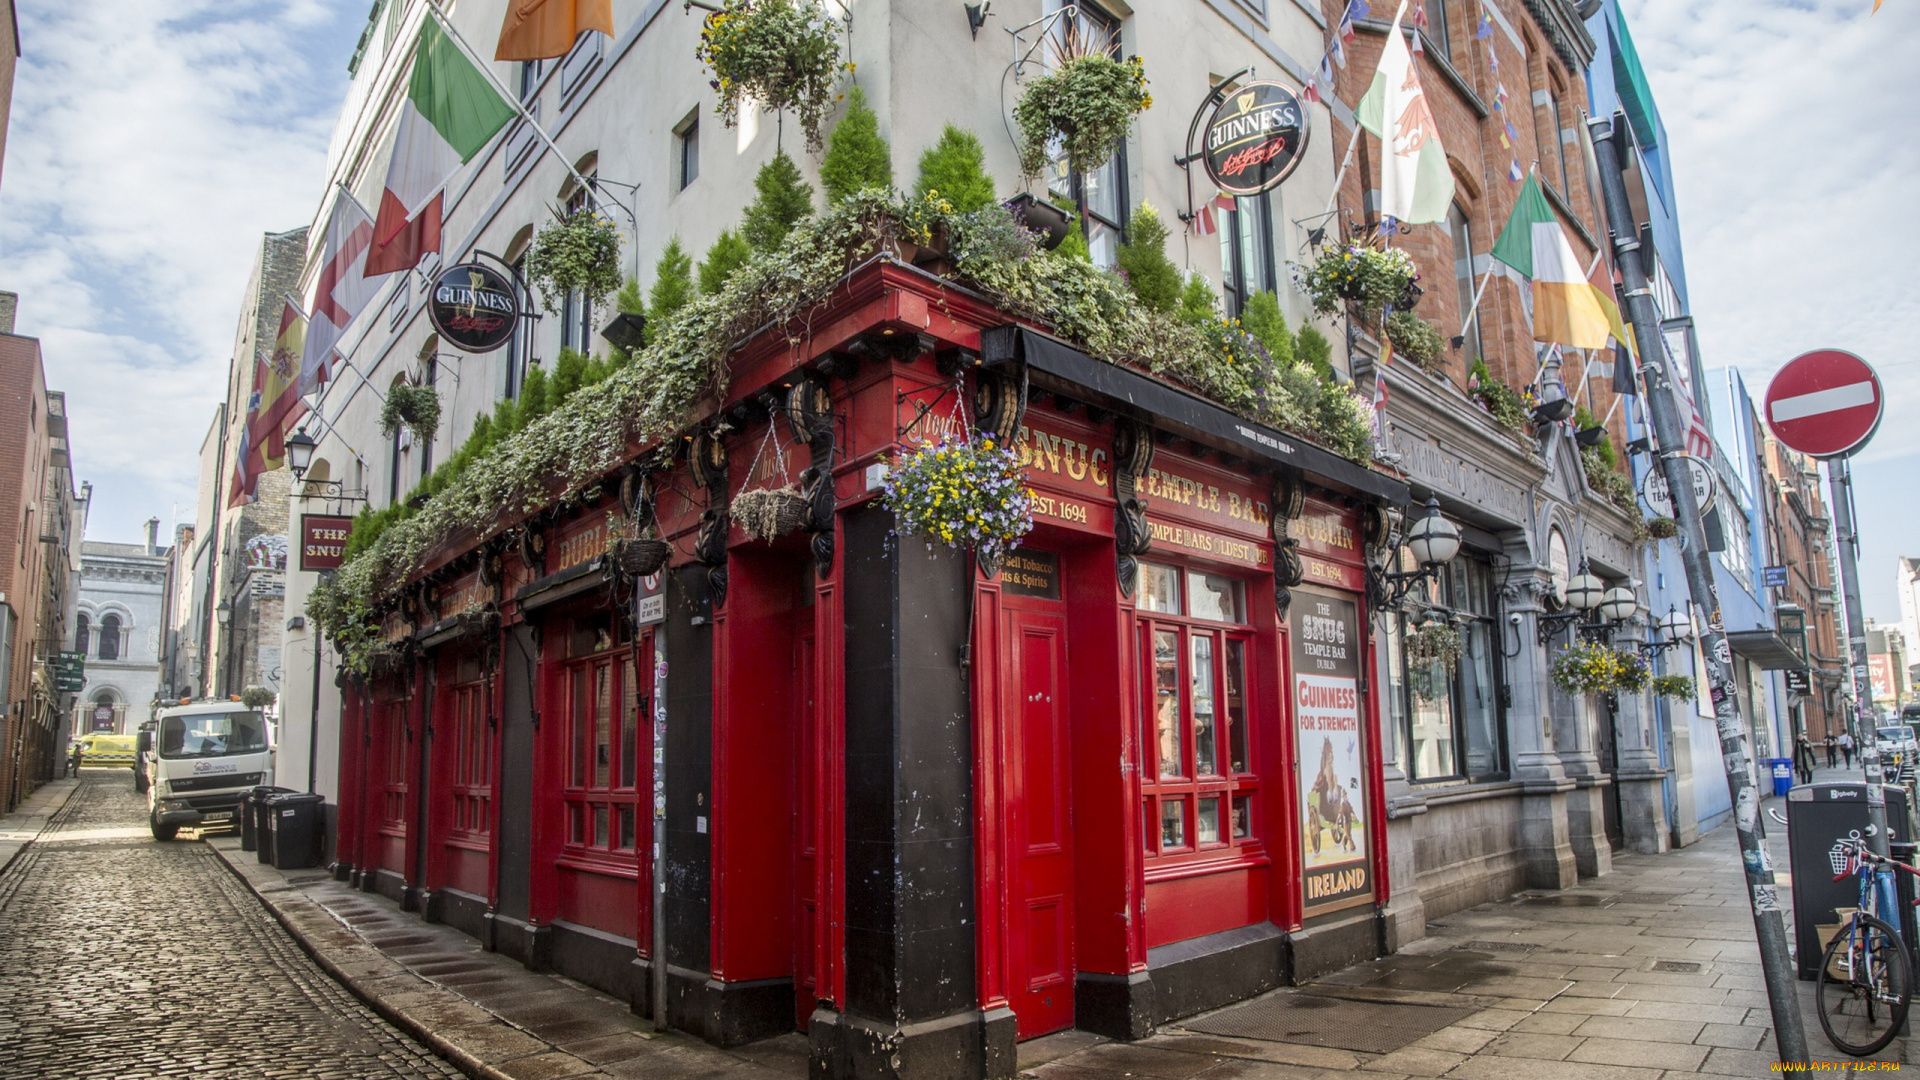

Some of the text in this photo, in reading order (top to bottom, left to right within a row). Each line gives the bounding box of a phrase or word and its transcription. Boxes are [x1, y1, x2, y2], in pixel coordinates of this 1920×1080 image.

[1207, 107, 1296, 150] GUINNESS
[436, 286, 513, 313] GUINNESS
[1011, 426, 1109, 487] SNUG
[1031, 496, 1087, 523] EST. 1694
[1228, 491, 1270, 528] BAR
[311, 528, 347, 540] THE
[1147, 522, 1268, 565] EMPLE BARS OLDEST PUB
[1294, 514, 1354, 551] DUBLIN
[306, 544, 345, 557] SNU
[1022, 558, 1053, 574] Tobacco
[1327, 565, 1342, 580] 1694
[1013, 572, 1021, 584] &
[1022, 573, 1048, 588] Spirits
[1317, 602, 1330, 616] THE
[1302, 614, 1346, 644] SNUG
[1303, 642, 1346, 659] TEMPLE BAR
[1317, 659, 1336, 670] DUBLIN
[1299, 680, 1355, 710] GUINNESS
[1300, 715, 1357, 731] FOR STRENGTH
[1831, 789, 1858, 799] Bigbelly
[1307, 867, 1366, 900] IRELAND
